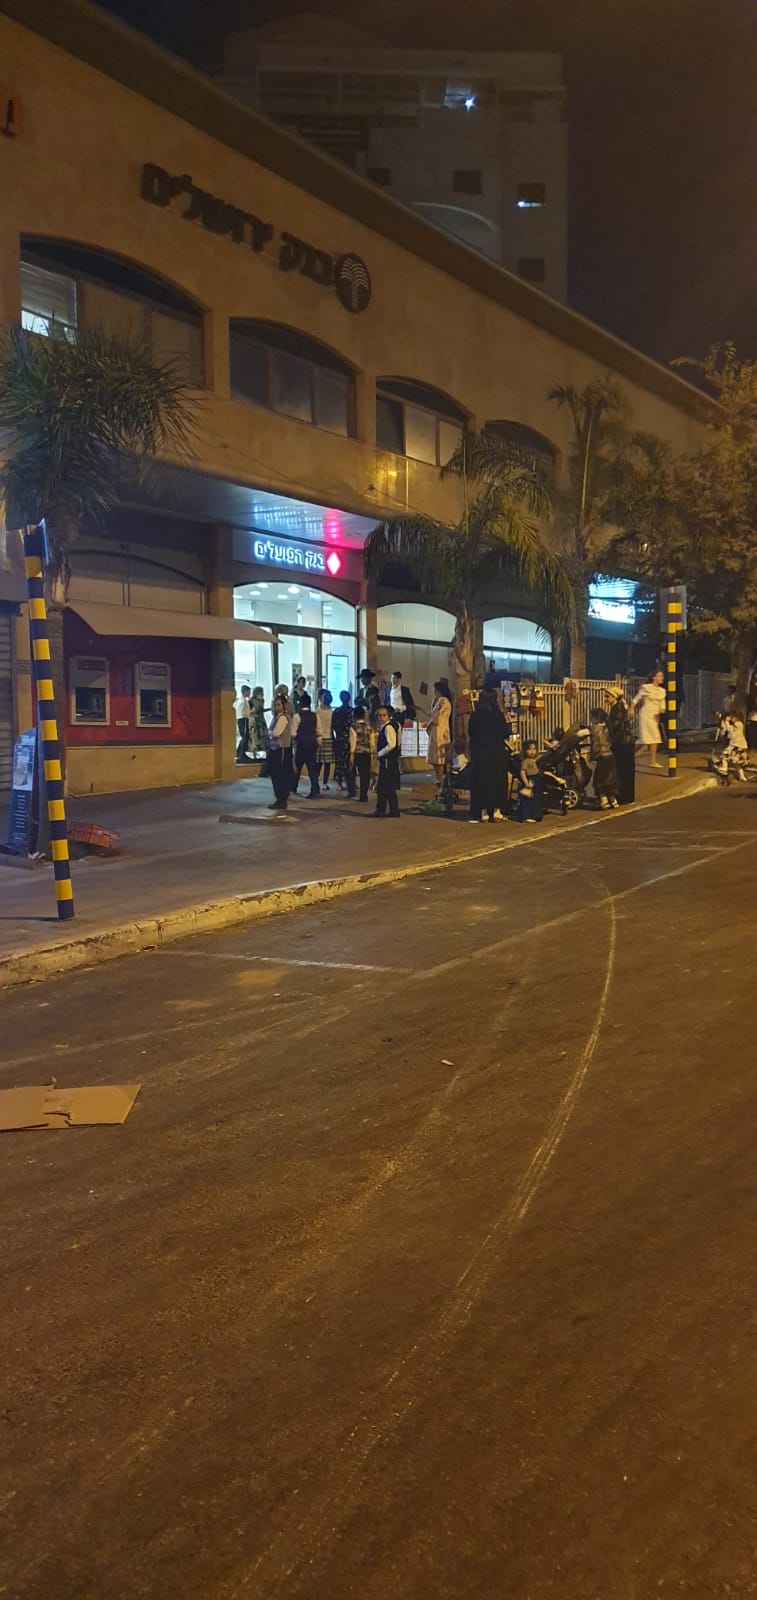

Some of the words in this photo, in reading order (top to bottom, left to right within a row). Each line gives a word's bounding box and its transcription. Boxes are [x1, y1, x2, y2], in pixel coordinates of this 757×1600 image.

[140, 162, 274, 252] ירושלים
[279, 231, 334, 286] בנק
[254, 540, 304, 566] הפועלים
[305, 551, 326, 569] בנק
